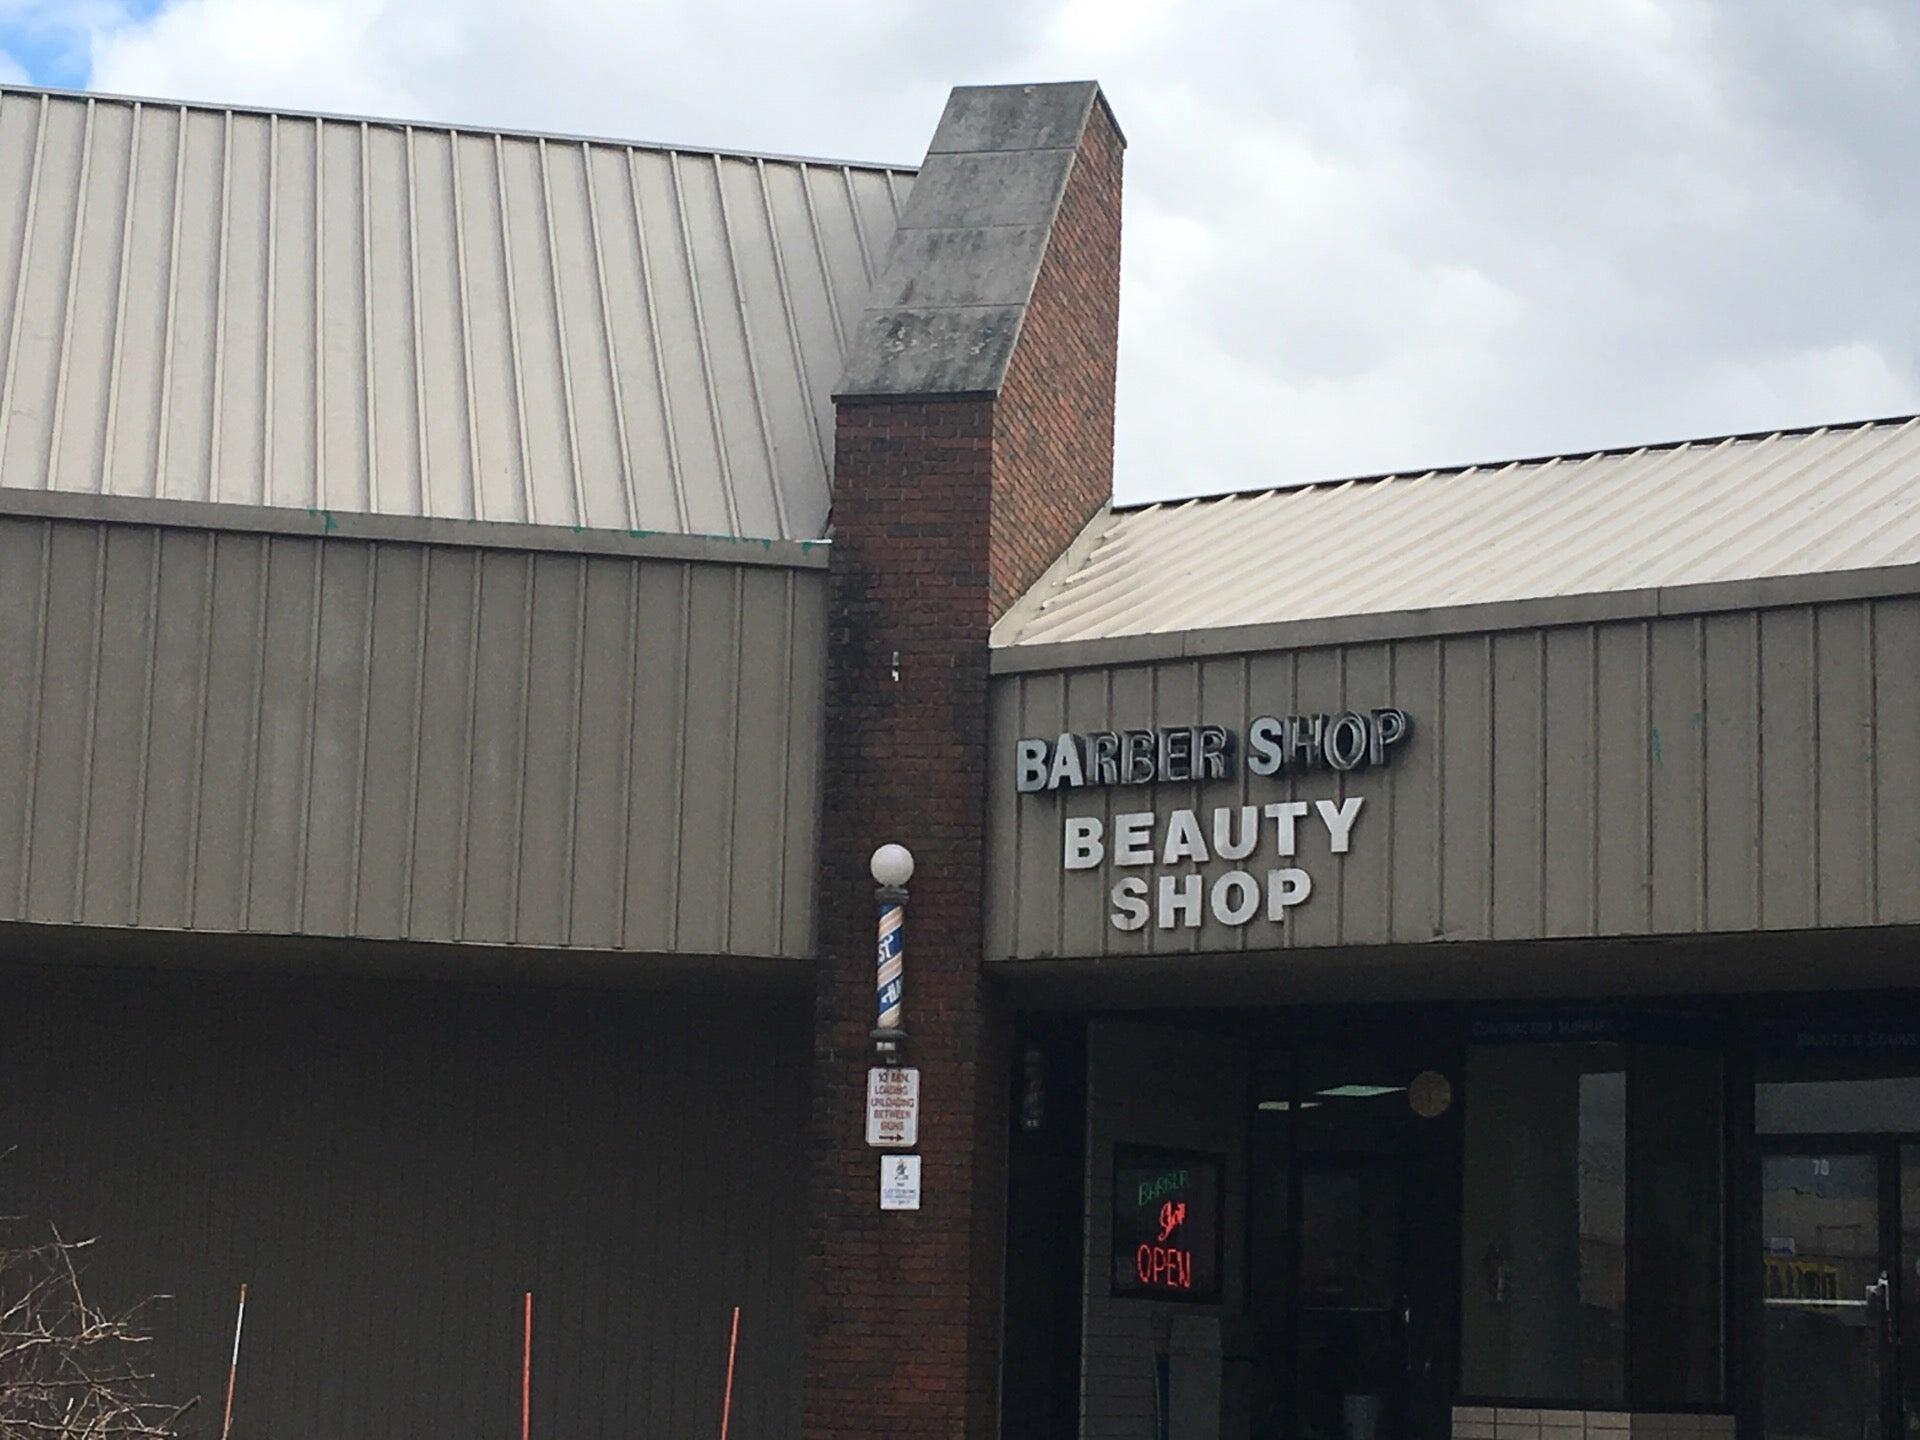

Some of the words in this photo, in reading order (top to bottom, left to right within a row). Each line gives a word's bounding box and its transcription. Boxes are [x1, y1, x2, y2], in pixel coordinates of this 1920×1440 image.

[1016, 723, 1230, 794] BARBER
[1247, 706, 1410, 776] SHOP
[1063, 796, 1365, 870] BEAUTY
[1110, 867, 1313, 931] SHOP
[1137, 1243, 1191, 1288] OPEN
